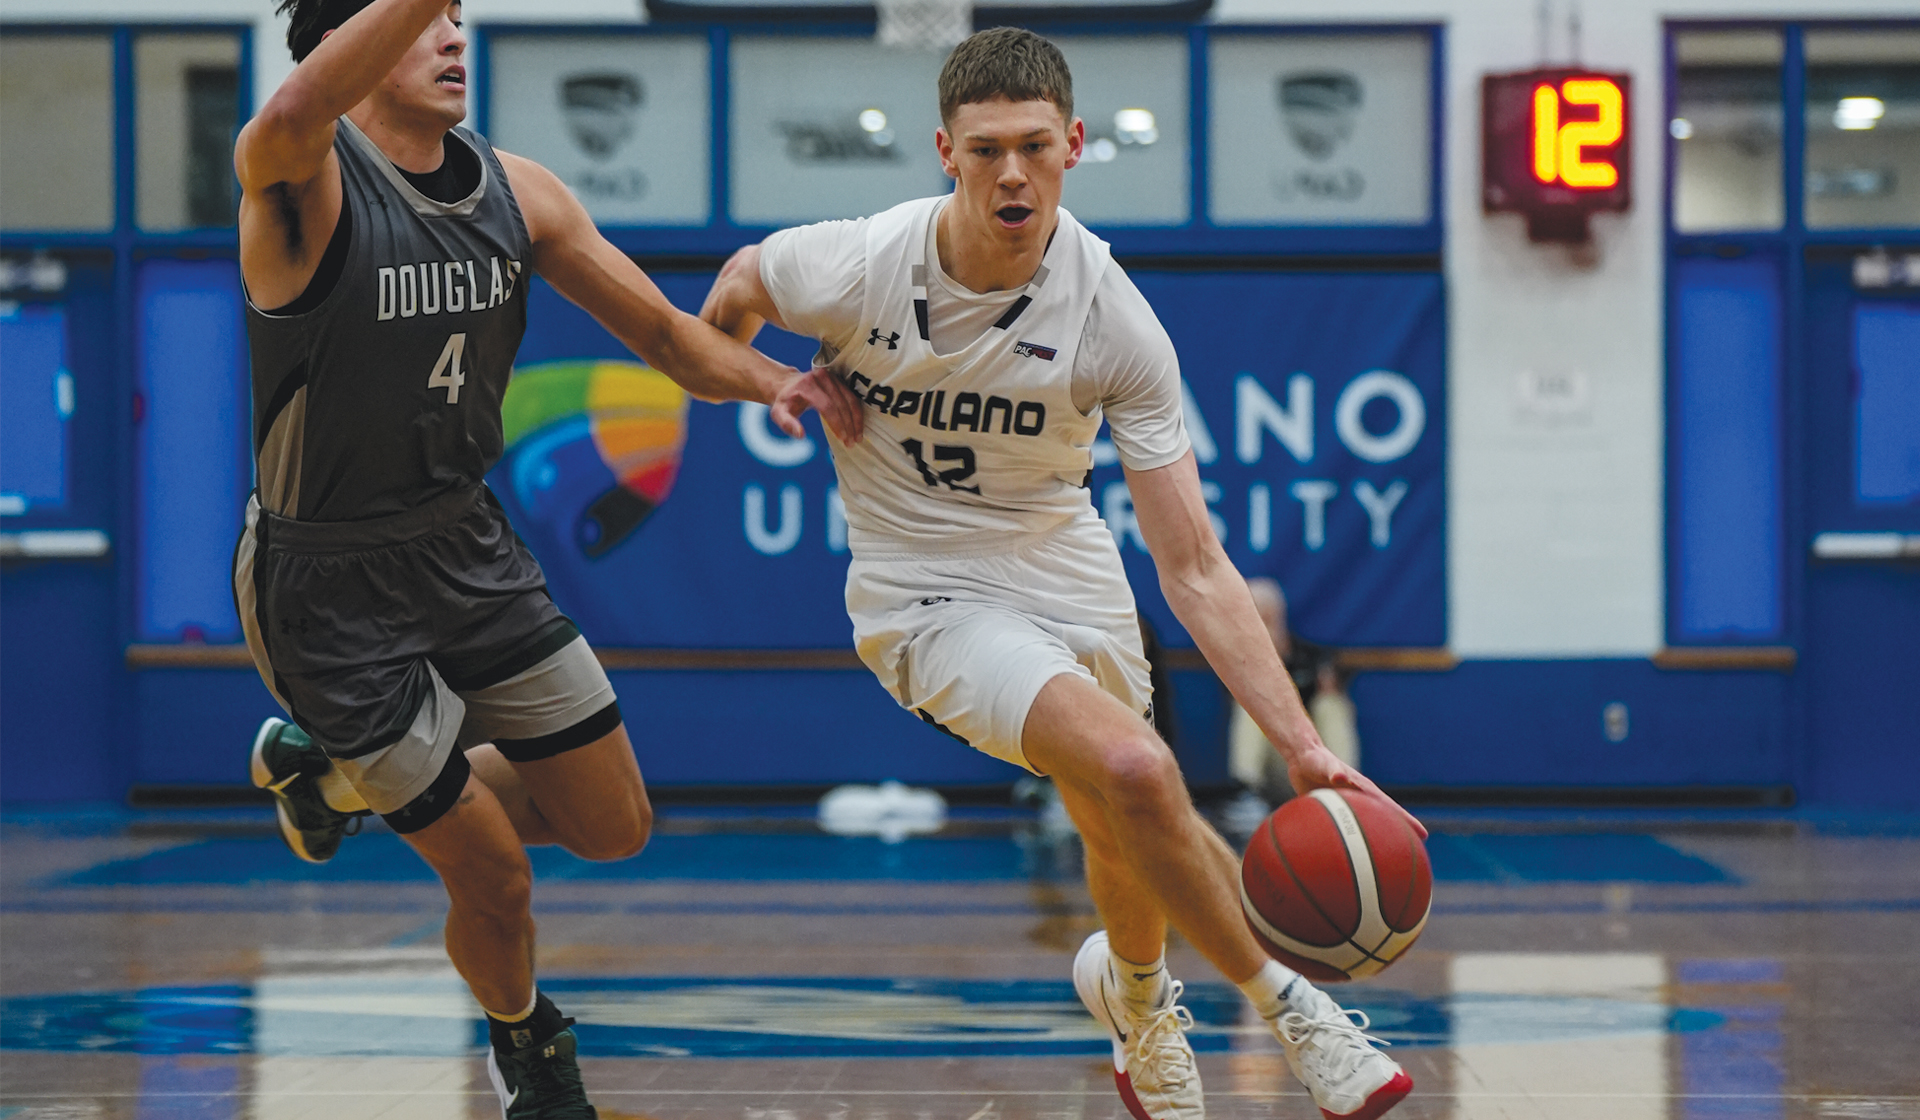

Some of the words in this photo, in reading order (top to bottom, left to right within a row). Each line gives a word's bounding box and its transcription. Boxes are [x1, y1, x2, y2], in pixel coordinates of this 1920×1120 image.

[1534, 79, 1623, 188] 12
[427, 333, 466, 404] 4
[900, 437, 981, 495] 12
